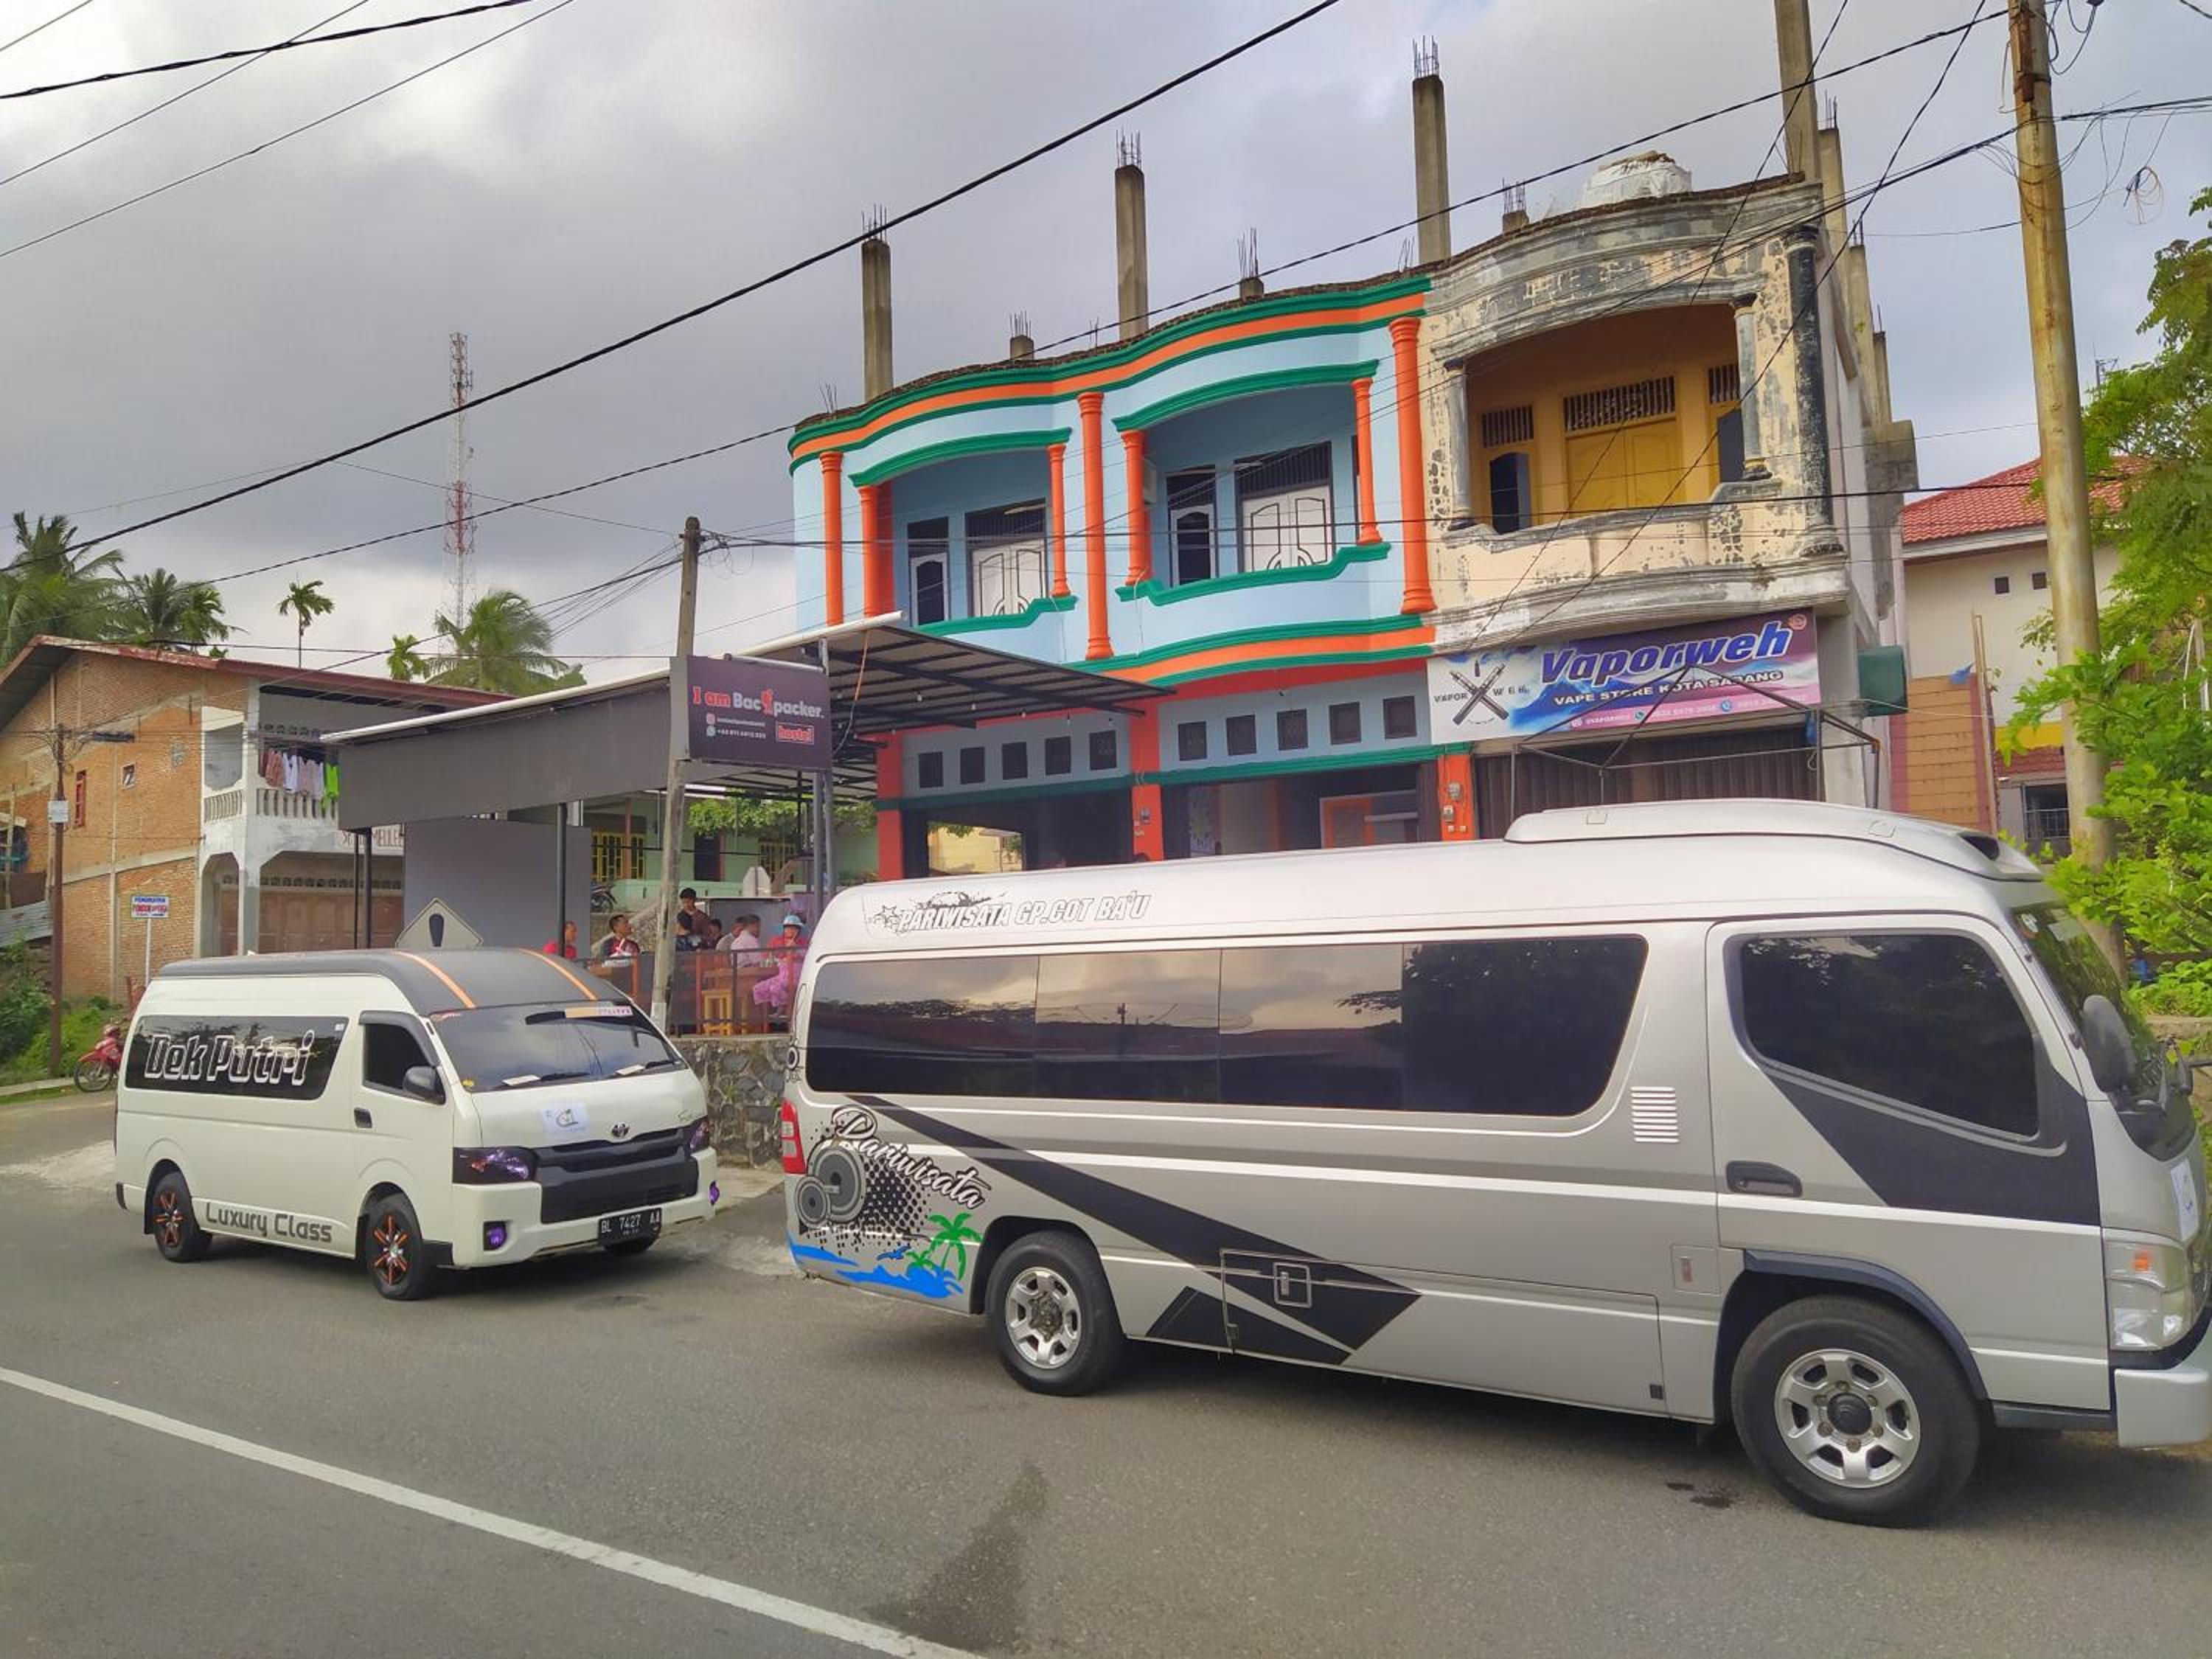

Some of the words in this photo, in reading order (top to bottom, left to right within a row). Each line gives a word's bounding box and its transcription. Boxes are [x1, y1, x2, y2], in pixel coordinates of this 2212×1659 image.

[1540, 621, 1793, 686] Vaporweh
[693, 686, 701, 704] I
[705, 690, 731, 707] am
[1554, 693, 1595, 706] VAPE
[1599, 686, 1652, 700] STORE
[1659, 680, 1704, 694] KOTA
[899, 903, 1011, 932] PARIWISATA
[145, 1034, 207, 1079] Dek
[206, 1030, 314, 1085] Putri
[832, 1105, 991, 1210] Pariwisata
[206, 1202, 268, 1237] Luxury
[274, 1213, 333, 1243] Class
[601, 1220, 612, 1234] BL
[619, 1213, 641, 1231] 7427
